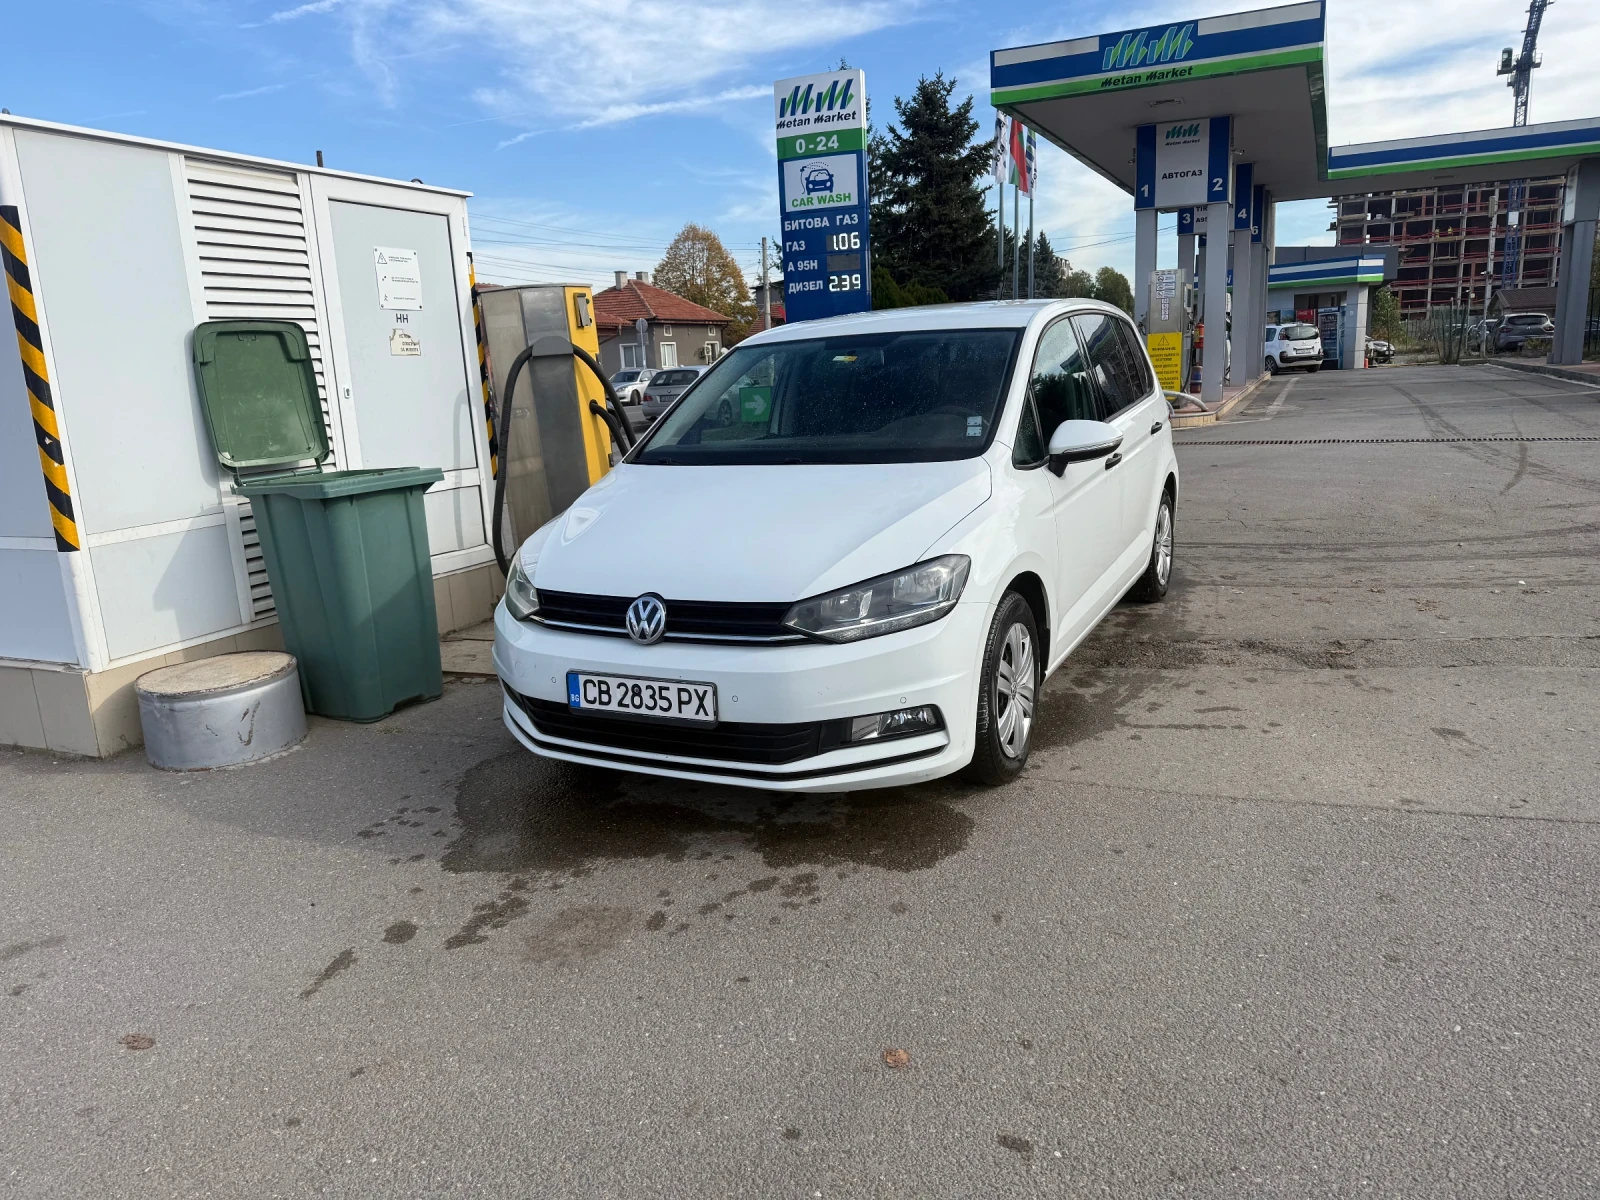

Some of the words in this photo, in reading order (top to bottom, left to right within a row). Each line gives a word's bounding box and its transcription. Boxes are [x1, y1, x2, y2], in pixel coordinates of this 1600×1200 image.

[1101, 74, 1141, 88] Metan
[1146, 66, 1193, 82] Market
[777, 117, 810, 130] Metan
[814, 111, 856, 125] Market
[1162, 170, 1202, 179] АВТОГАЗ
[1141, 184, 1149, 197] 1
[1212, 178, 1223, 191] 2
[792, 195, 814, 208] CAR
[816, 193, 851, 205] WASH
[1182, 213, 1191, 224] 3
[1238, 208, 1247, 219] 4
[785, 217, 829, 231] БИТОВА
[837, 214, 858, 226] ГАЗ
[1251, 226, 1258, 235] 6
[786, 241, 806, 252] ГАЗ
[788, 262, 795, 271] А
[797, 260, 818, 270] 95Н
[789, 281, 823, 294] ДИЗЕЛ
[571, 694, 579, 702] BG
[616, 682, 672, 712] 2835
